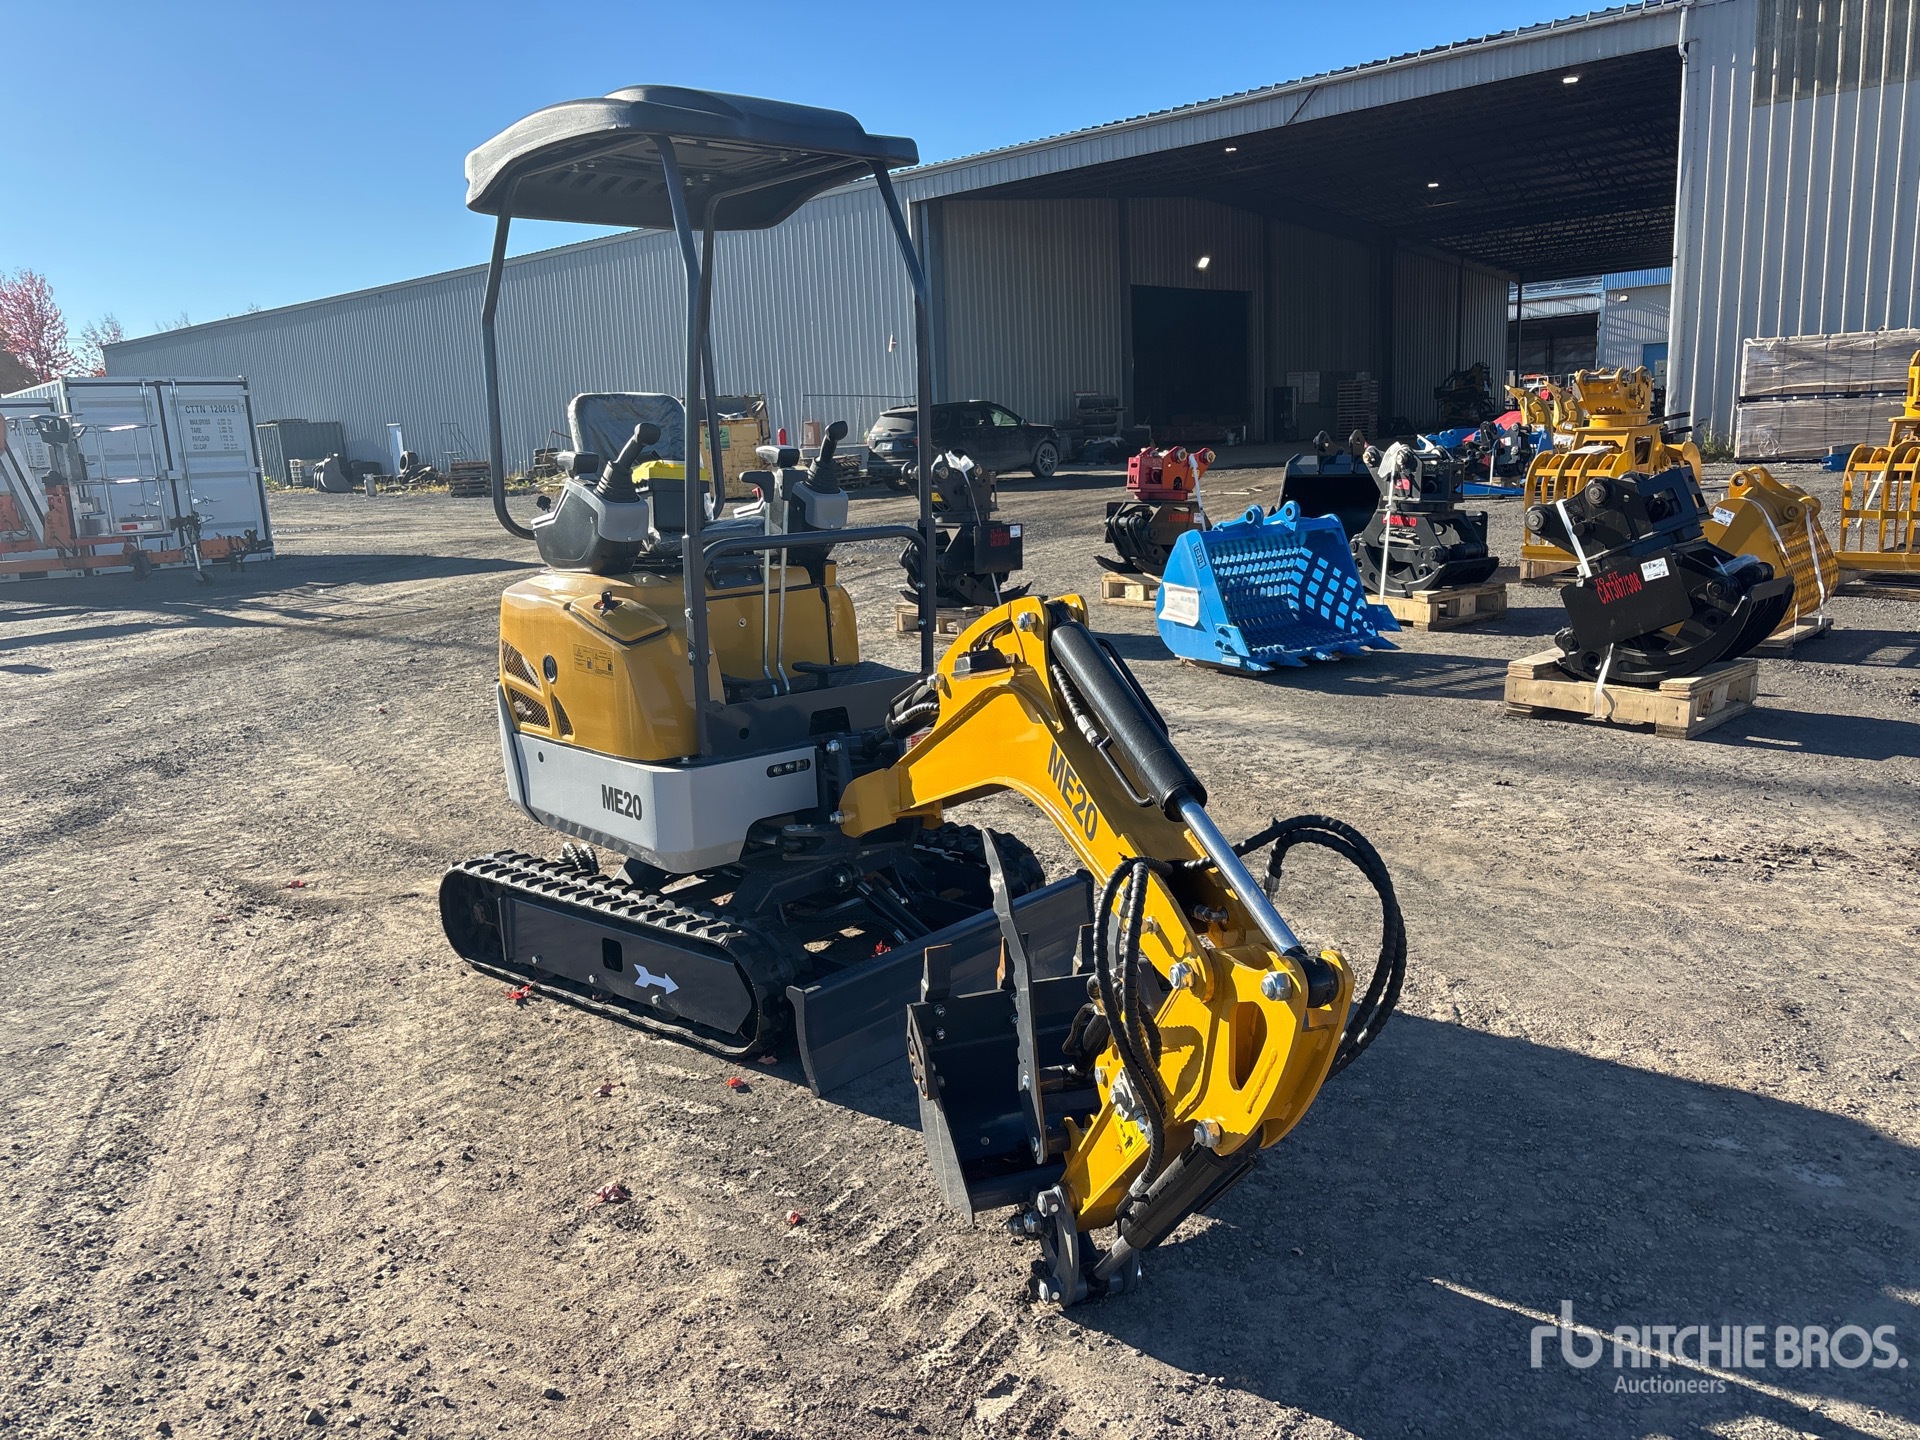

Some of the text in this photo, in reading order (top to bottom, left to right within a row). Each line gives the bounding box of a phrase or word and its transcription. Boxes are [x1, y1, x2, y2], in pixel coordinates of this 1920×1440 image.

[1594, 571, 1619, 586] TO FIT
[601, 784, 643, 821] ME20
[1048, 741, 1098, 841] ME20
